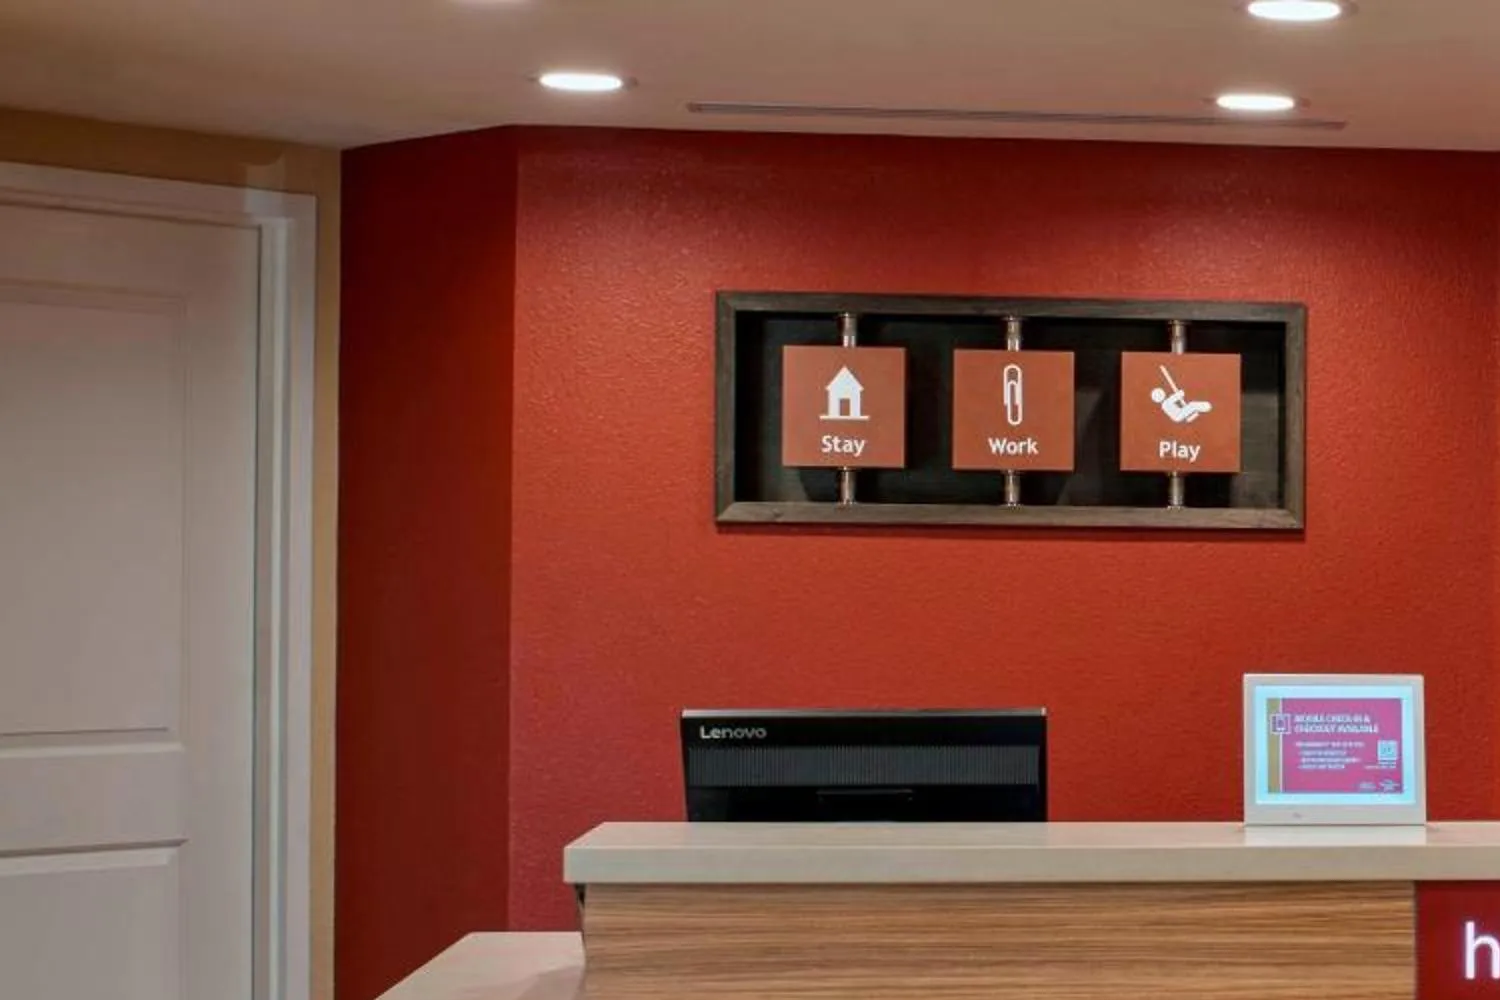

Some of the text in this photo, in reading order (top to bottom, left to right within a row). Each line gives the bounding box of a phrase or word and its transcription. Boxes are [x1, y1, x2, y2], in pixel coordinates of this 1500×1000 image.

[821, 434, 866, 457] Stay
[988, 437, 1039, 456] Work
[1159, 440, 1201, 462] Play
[699, 726, 767, 739] Lenovo
